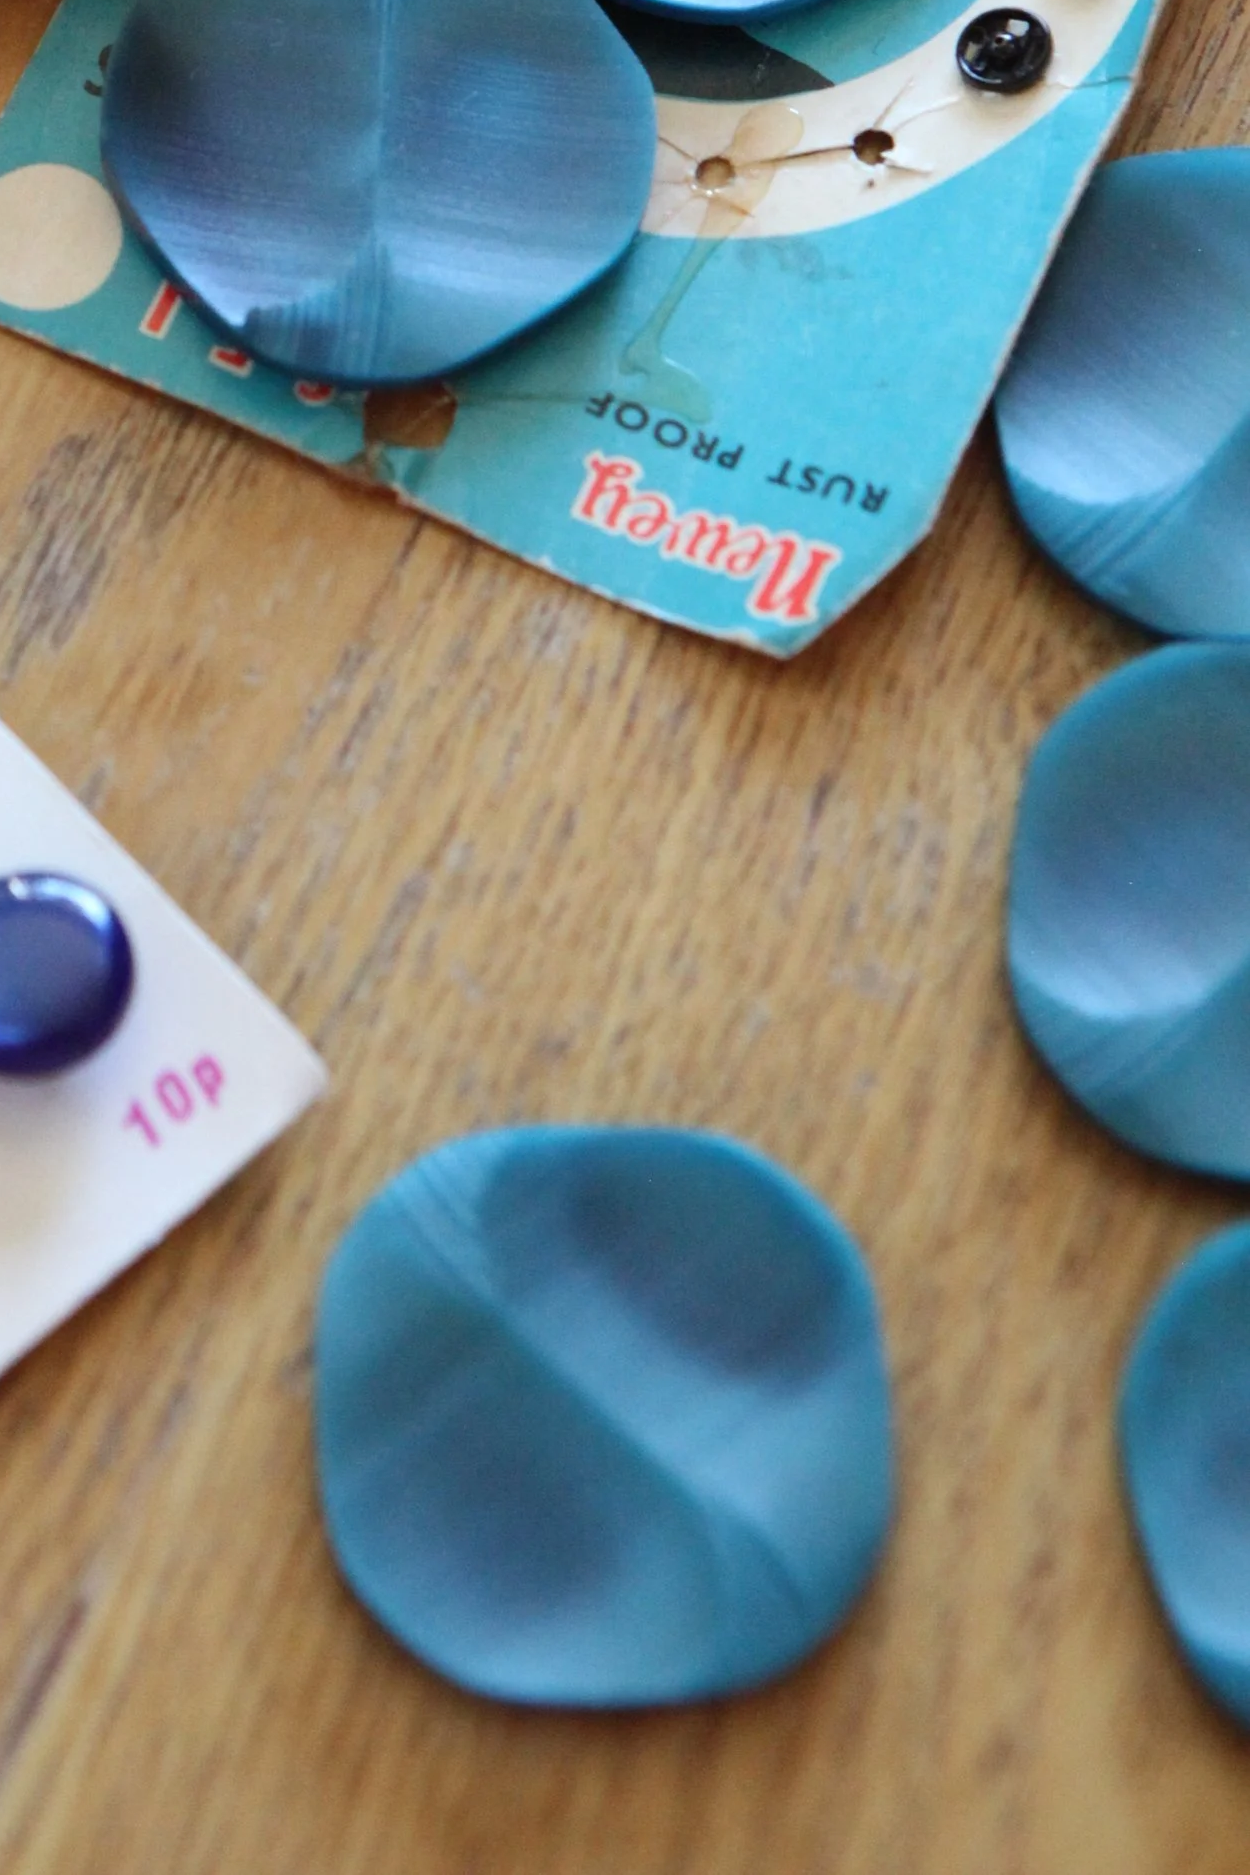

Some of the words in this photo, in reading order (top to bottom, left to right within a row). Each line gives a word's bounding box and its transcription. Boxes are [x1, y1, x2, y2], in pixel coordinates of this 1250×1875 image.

[584, 391, 746, 471] PROOF
[766, 457, 890, 515] RUST
[575, 452, 840, 622] Newey
